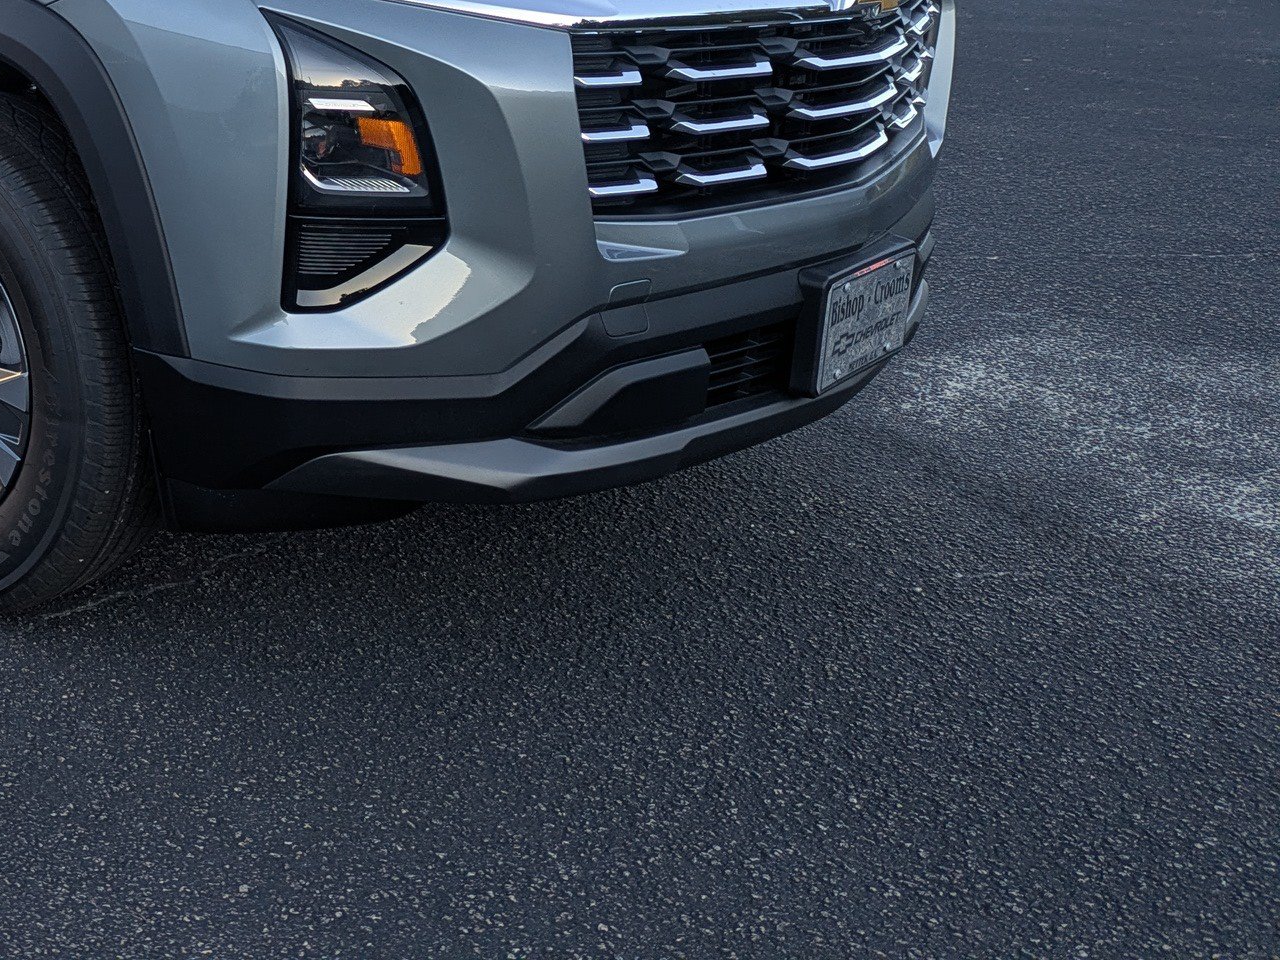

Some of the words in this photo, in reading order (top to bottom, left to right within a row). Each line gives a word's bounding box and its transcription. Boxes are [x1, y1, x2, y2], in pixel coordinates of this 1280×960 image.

[831, 294, 864, 328] Bishop
[874, 272, 910, 305] Crooms
[854, 311, 901, 344] CHEVROLET
